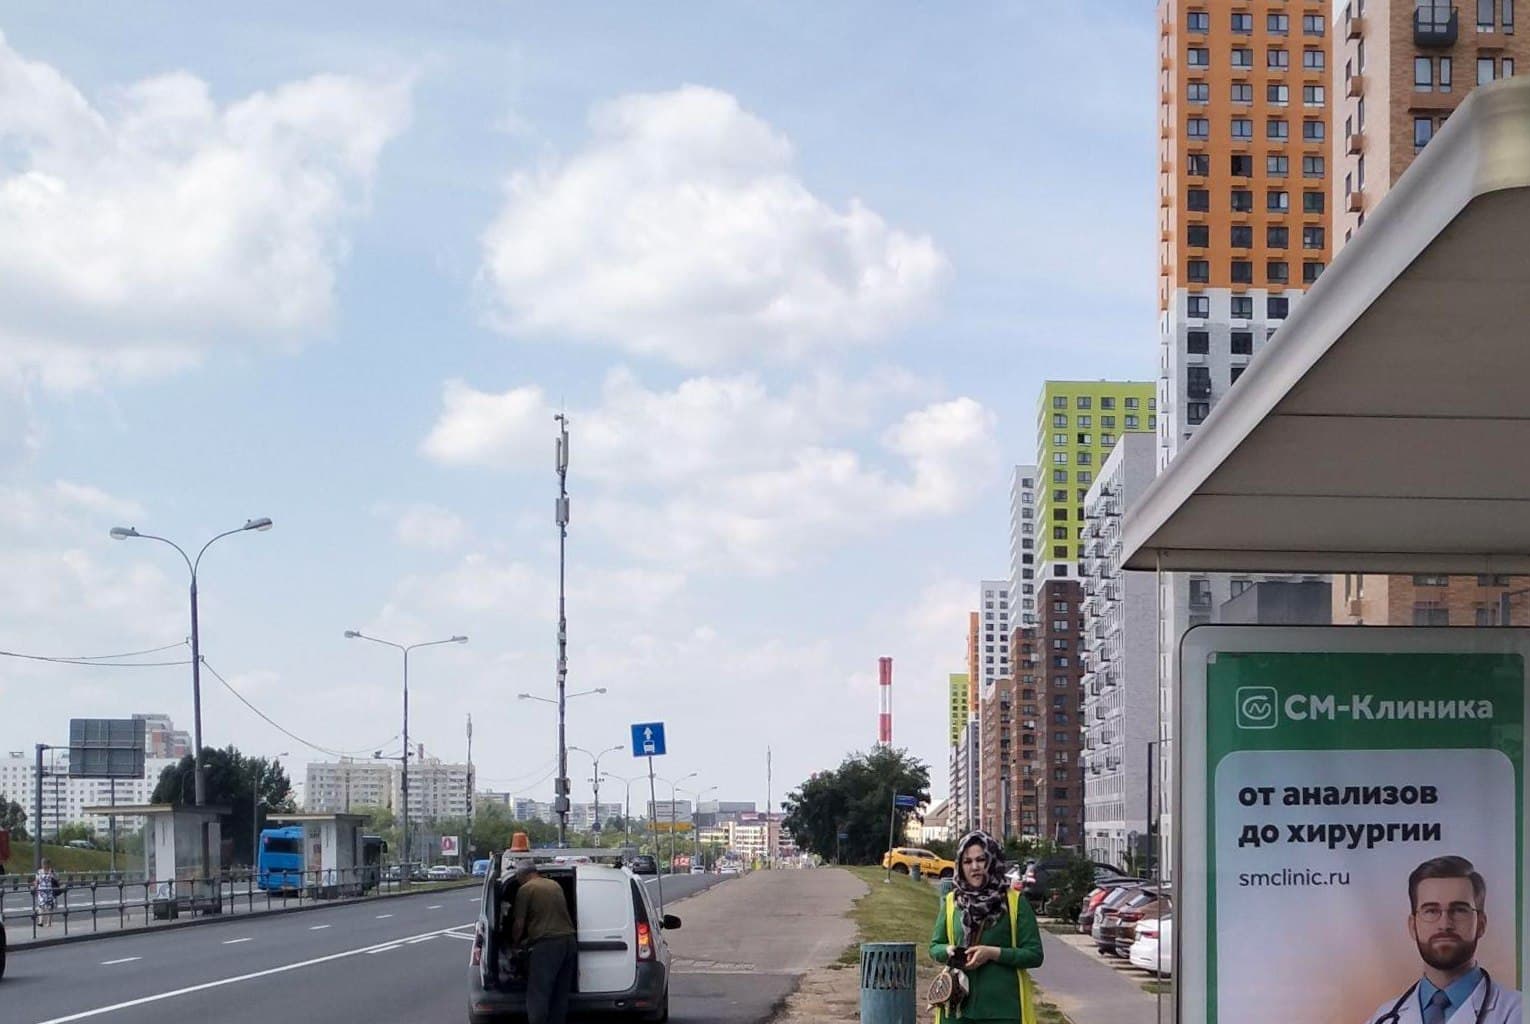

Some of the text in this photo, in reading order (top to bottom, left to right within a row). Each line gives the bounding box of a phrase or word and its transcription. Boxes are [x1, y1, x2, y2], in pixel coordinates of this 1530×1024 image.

[1284, 693, 1494, 721] СМ-Клиника
[1238, 783, 1439, 807] от анализов
[1238, 821, 1441, 849] до хирургии
[1239, 868, 1351, 887] smclinic.ru
